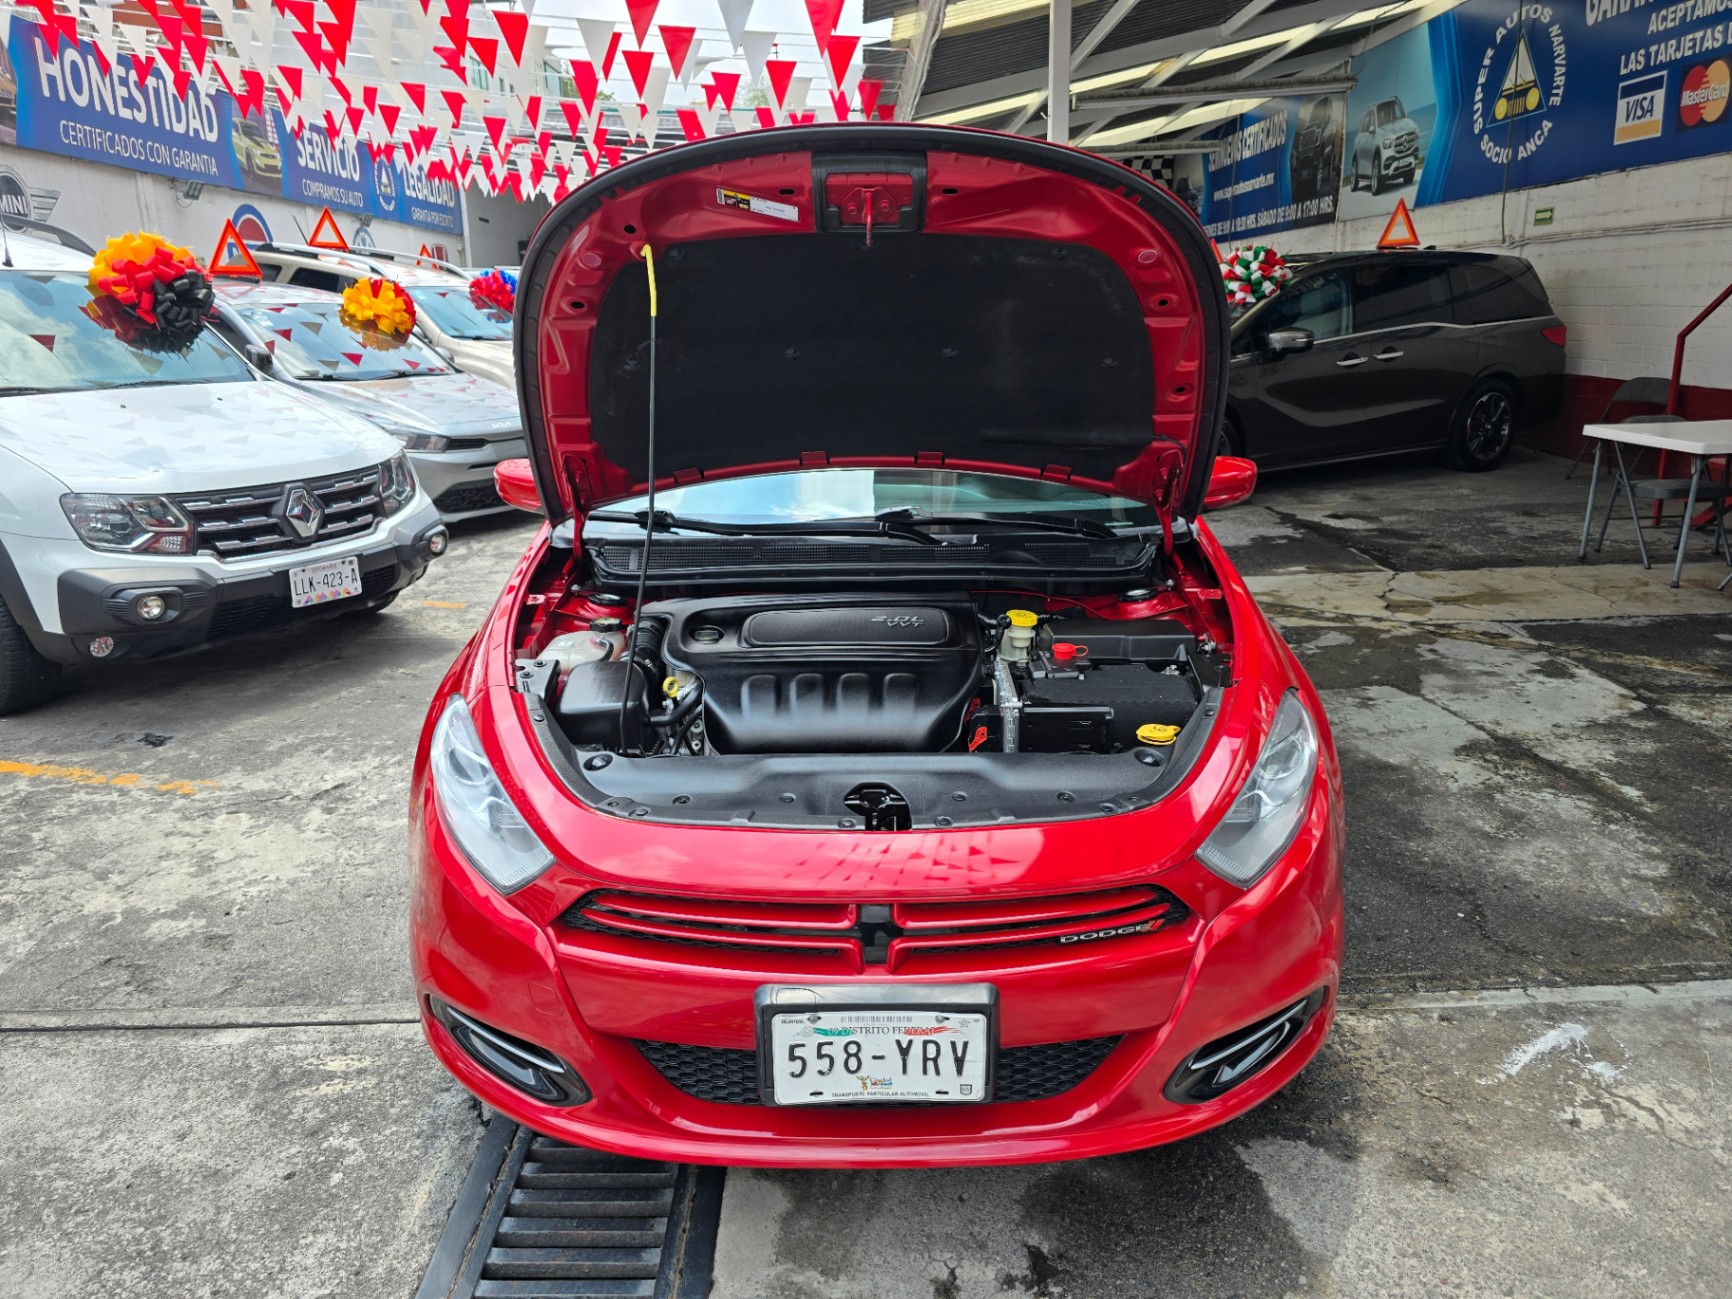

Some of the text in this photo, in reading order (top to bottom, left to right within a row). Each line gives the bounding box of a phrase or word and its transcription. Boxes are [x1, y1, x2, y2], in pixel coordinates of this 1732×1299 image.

[1495, 4, 1553, 45] AUTOS
[1548, 23, 1566, 106] NARVARTE
[1619, 48, 1646, 75] LAS
[1649, 24, 1724, 67] TARJETAS
[34, 36, 219, 143] HONESTIDAD
[1473, 47, 1495, 134] SUPER
[1625, 95, 1655, 123] VISA
[1680, 83, 1731, 108] MasterCard
[60, 120, 219, 176] CERTIFICADOS CON GARANTIA
[296, 129, 360, 182] SERVICIO
[1242, 110, 1288, 160] CERTIFICADOS
[1480, 134, 1512, 164] SOCIO
[1517, 119, 1553, 160] ANCA
[0, 194, 28, 215] MINI
[302, 178, 341, 203] COMPRAMOS
[340, 190, 349, 205] SU
[348, 192, 363, 208] AUTO
[1277, 206, 1285, 224] DE
[1297, 202, 1302, 220] A
[1302, 198, 1319, 218] 17:00
[1319, 195, 1335, 215] HRS.
[293, 567, 358, 596] LLK-423-A
[1060, 922, 1151, 943] DODGE
[841, 1026, 890, 1036] DISTRITO
[892, 1026, 936, 1036] FEDERAL
[787, 1038, 970, 1079] 558-YRV
